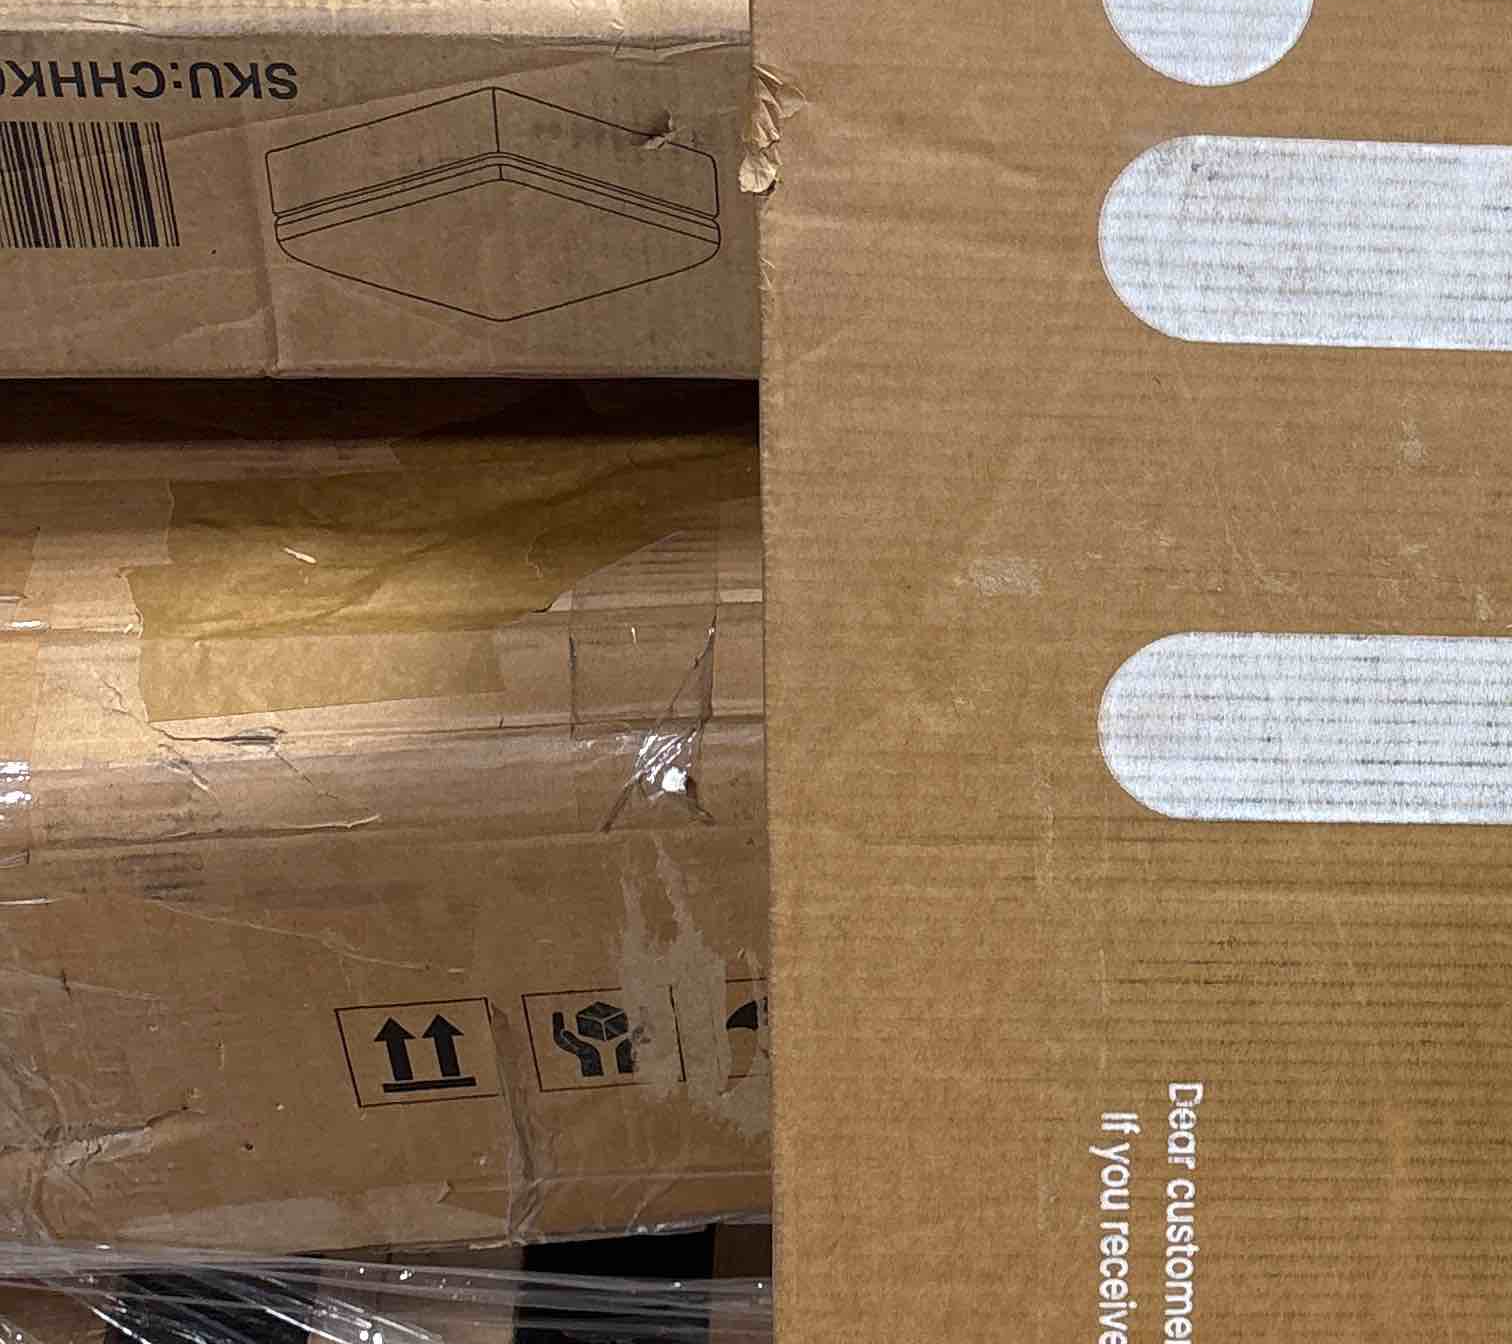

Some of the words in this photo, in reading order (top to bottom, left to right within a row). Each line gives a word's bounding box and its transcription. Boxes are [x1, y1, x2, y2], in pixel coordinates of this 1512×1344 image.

[0, 60, 298, 100] SKU:CHHK
[1101, 1112, 1142, 1135] If
[1167, 1082, 1204, 1170] Dear
[1088, 1142, 1131, 1211] you
